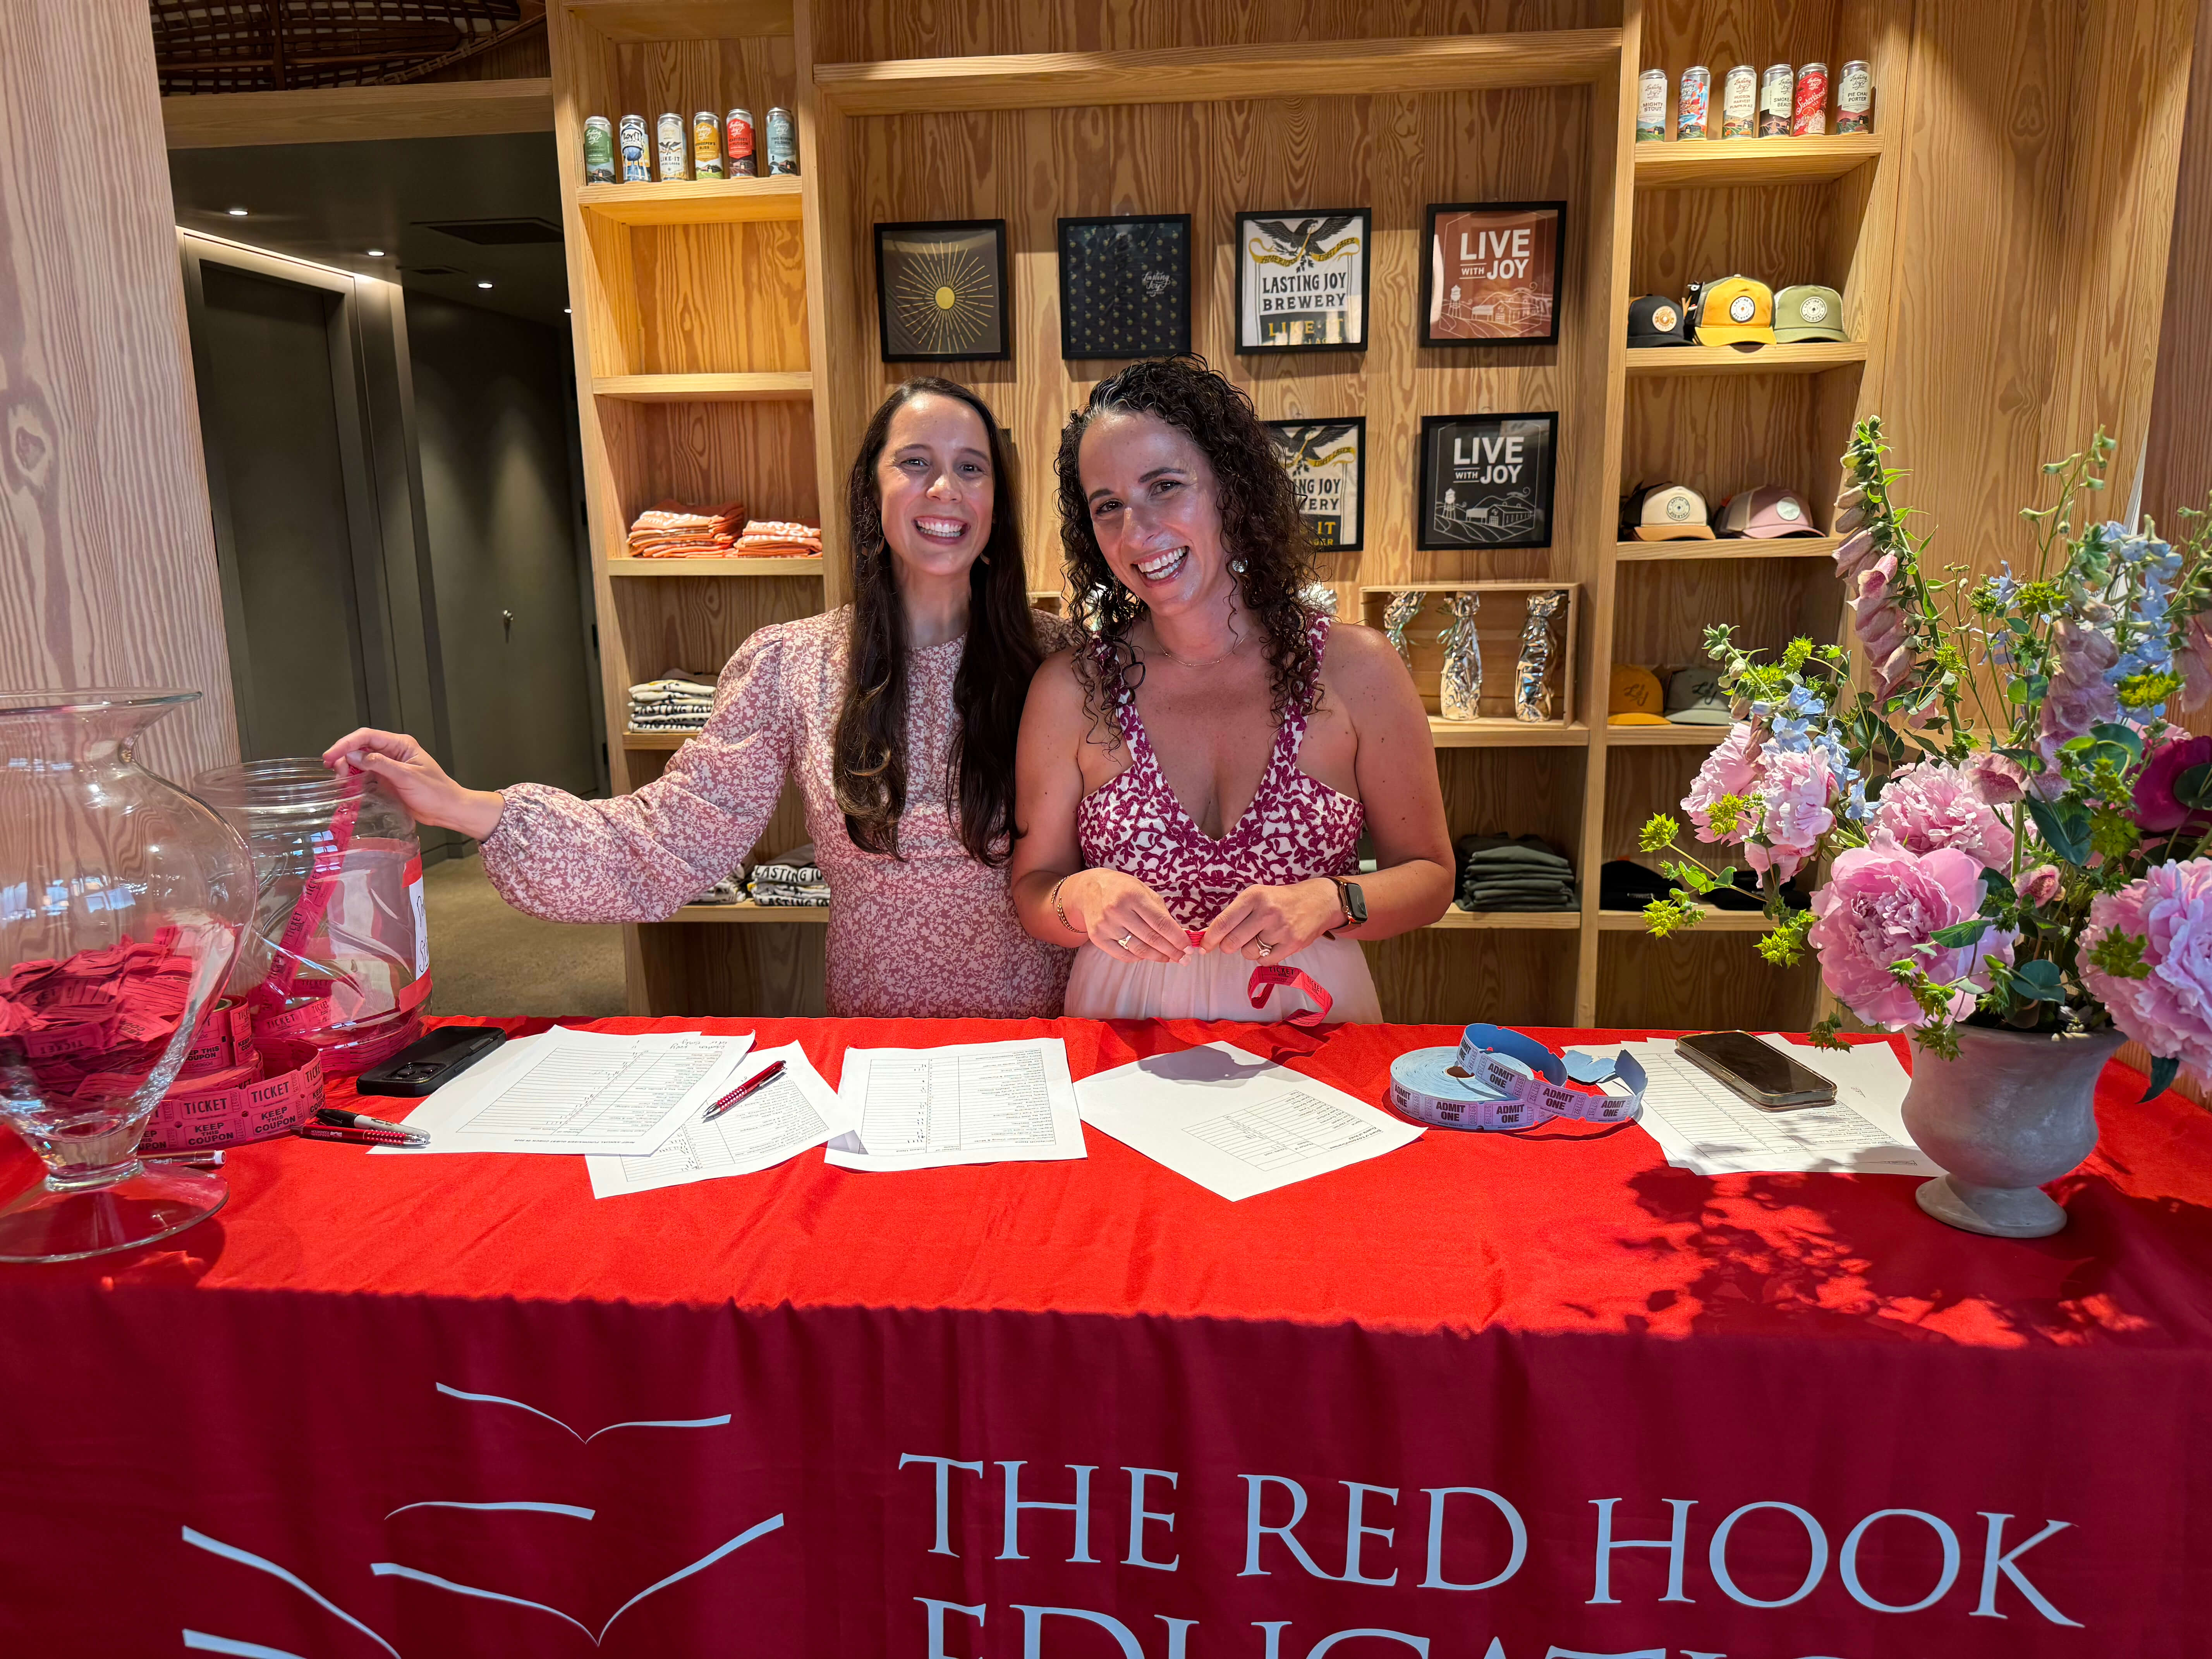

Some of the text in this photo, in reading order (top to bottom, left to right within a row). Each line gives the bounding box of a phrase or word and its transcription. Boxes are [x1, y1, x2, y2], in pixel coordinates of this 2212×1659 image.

[1460, 229, 1530, 260] LIVE
[1462, 259, 1529, 280] WITH JOY
[1142, 270, 1171, 288] Lasting
[1262, 272, 1346, 294] LASTING JOY
[1263, 293, 1346, 311] BREWERY
[1454, 437, 1524, 465] LIVE
[1455, 465, 1523, 484] WITH JOY
[1318, 479, 1341, 495] JOY
[755, 866, 823, 883] LASTING JO
[759, 898, 812, 907] LASTING
[286, 911, 303, 938] TICKET
[1269, 966, 1295, 975] TICKET
[1307, 975, 1322, 994] TICKET
[312, 1000, 329, 1013] TICKET
[267, 1014, 295, 1029] TICKET
[201, 1046, 220, 1054] THIS
[1488, 1063, 1515, 1082] ADMIT
[1489, 1074, 1507, 1089] ONE
[1515, 1077, 1525, 1097] 997793
[251, 1081, 289, 1103] TICKET
[1395, 1084, 1411, 1100] ADMIT
[1529, 1083, 1540, 1101] 997792
[1543, 1087, 1575, 1103] ADMIT
[184, 1098, 227, 1115] TICKET
[1397, 1096, 1407, 1108] ONE
[1436, 1101, 1465, 1113] ADMIT
[1496, 1104, 1525, 1114] ADMIT
[1546, 1098, 1566, 1110] ONE
[1574, 1096, 1584, 1115] 997792
[1589, 1098, 1599, 1116] 997791
[1601, 1100, 1626, 1108] ADMIT
[261, 1106, 287, 1120] KEEP
[1441, 1111, 1460, 1121] ONE
[1501, 1114, 1519, 1123] ONE
[195, 1122, 224, 1133] KEEP
[255, 1115, 296, 1133] COUPON
[188, 1132, 234, 1145] COUPON
[899, 1453, 2084, 1627] THE RED HOOK
